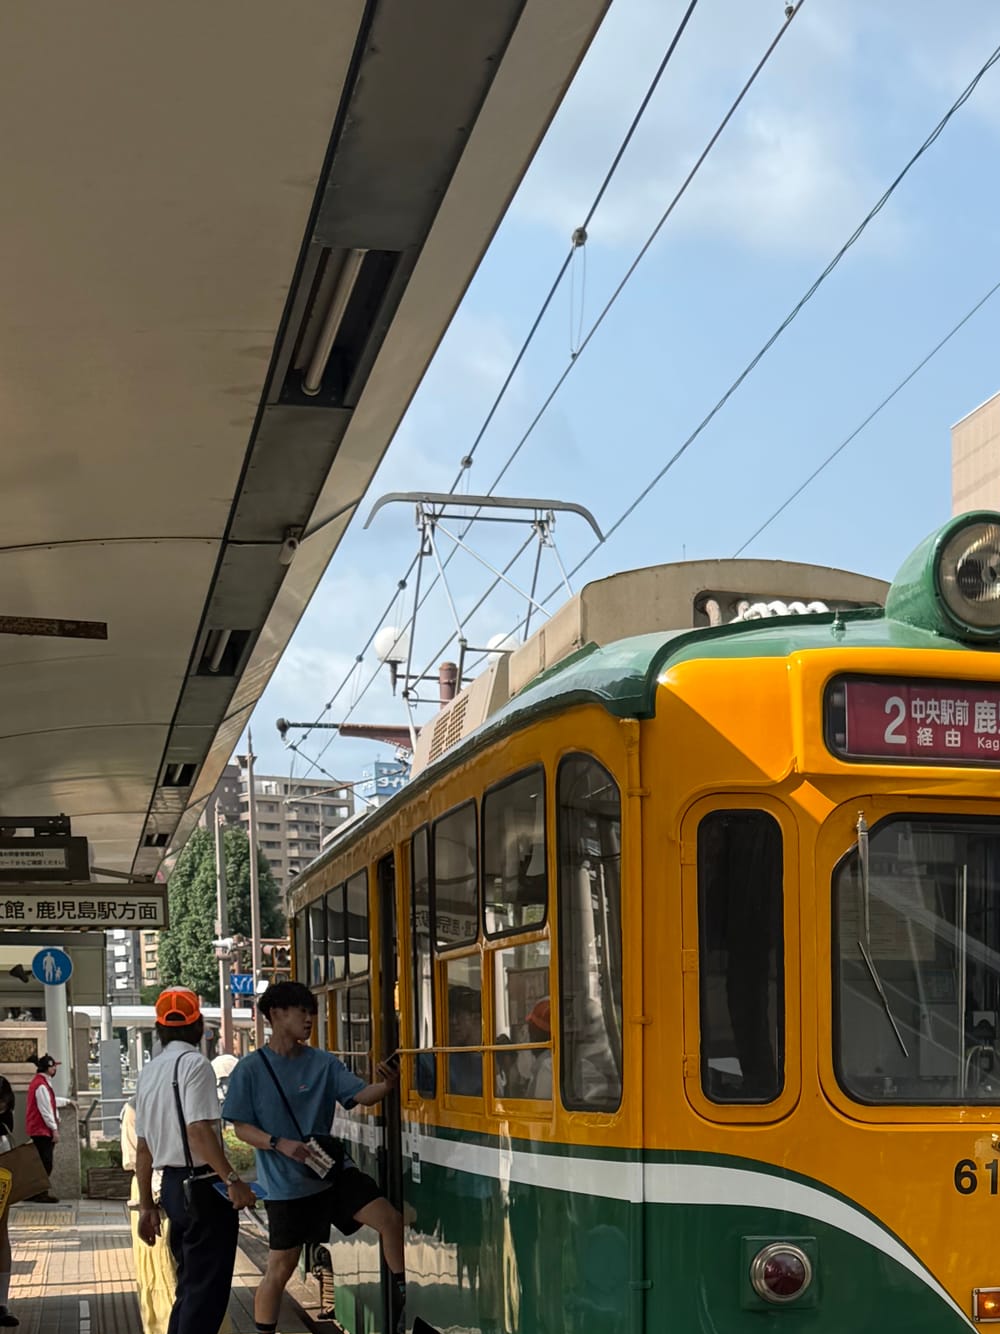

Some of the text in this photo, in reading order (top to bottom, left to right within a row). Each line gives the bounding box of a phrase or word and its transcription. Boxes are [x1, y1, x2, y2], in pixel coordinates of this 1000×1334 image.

[883, 695, 908, 745] 2
[911, 698, 970, 727] 中央駅前
[916, 727, 962, 748] 経由
[0, 900, 158, 921] 館・鹿児島駅方面
